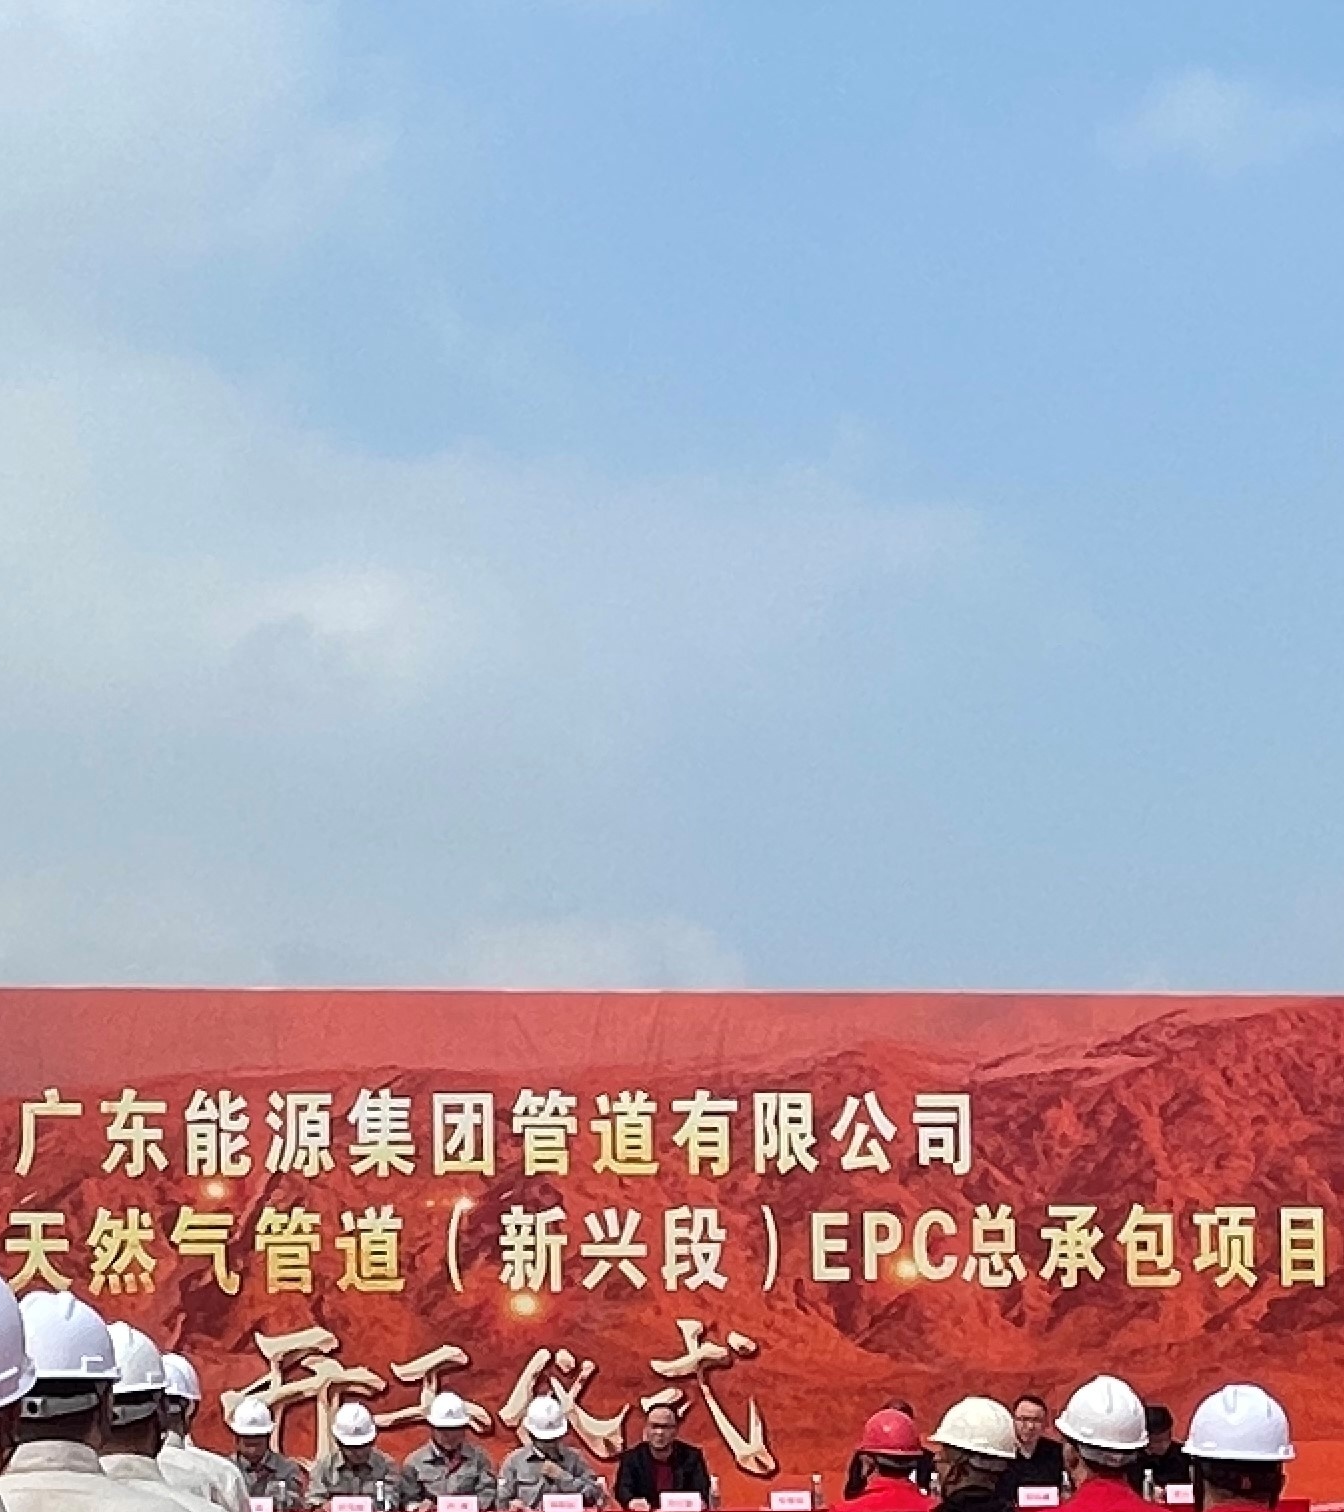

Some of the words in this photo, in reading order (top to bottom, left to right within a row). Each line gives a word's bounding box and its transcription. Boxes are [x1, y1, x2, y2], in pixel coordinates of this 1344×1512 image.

[14, 1087, 973, 1178] 广东能源集团管道有限公司
[220, 1318, 778, 1475] 开工仪式
